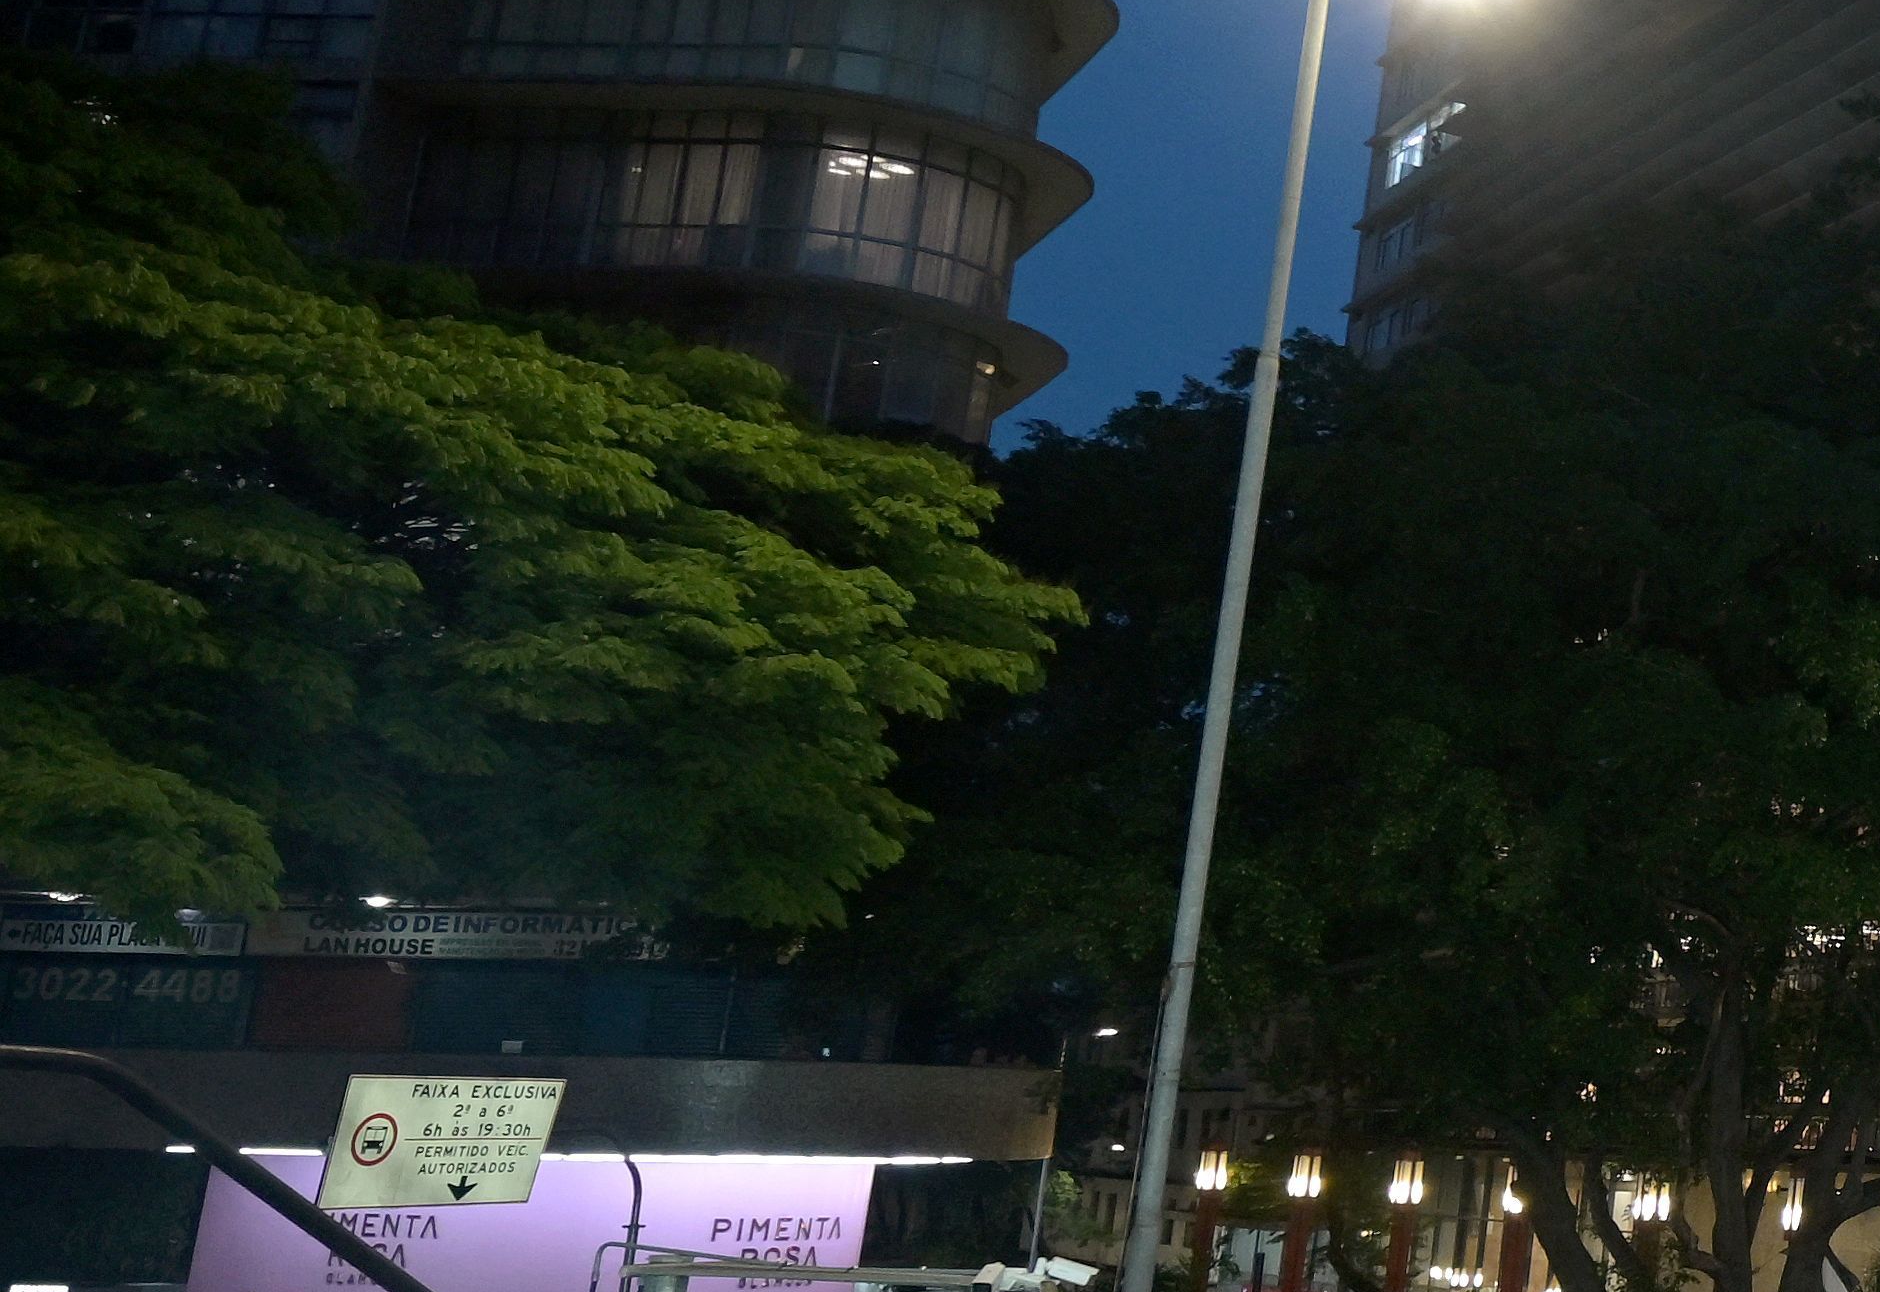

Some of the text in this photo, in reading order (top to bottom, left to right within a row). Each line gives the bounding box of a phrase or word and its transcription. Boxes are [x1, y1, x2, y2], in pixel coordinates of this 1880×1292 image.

[413, 913, 449, 933] DE
[453, 914, 630, 934] INFORMATIC
[22, 922, 64, 949] FAÇA
[69, 923, 96, 946] SUA
[304, 937, 348, 954] LAN
[354, 938, 434, 955] HOUSE
[412, 1084, 557, 1100] FAIXA EXCLUSIVA
[479, 1108, 486, 1118] a
[423, 1121, 531, 1137] 6h às 19:30h
[415, 1145, 489, 1158] PERMITIDO
[418, 1162, 516, 1175] AUTORIZADOS
[331, 1212, 437, 1239] MENTA
[710, 1216, 841, 1242] PIMENTA
